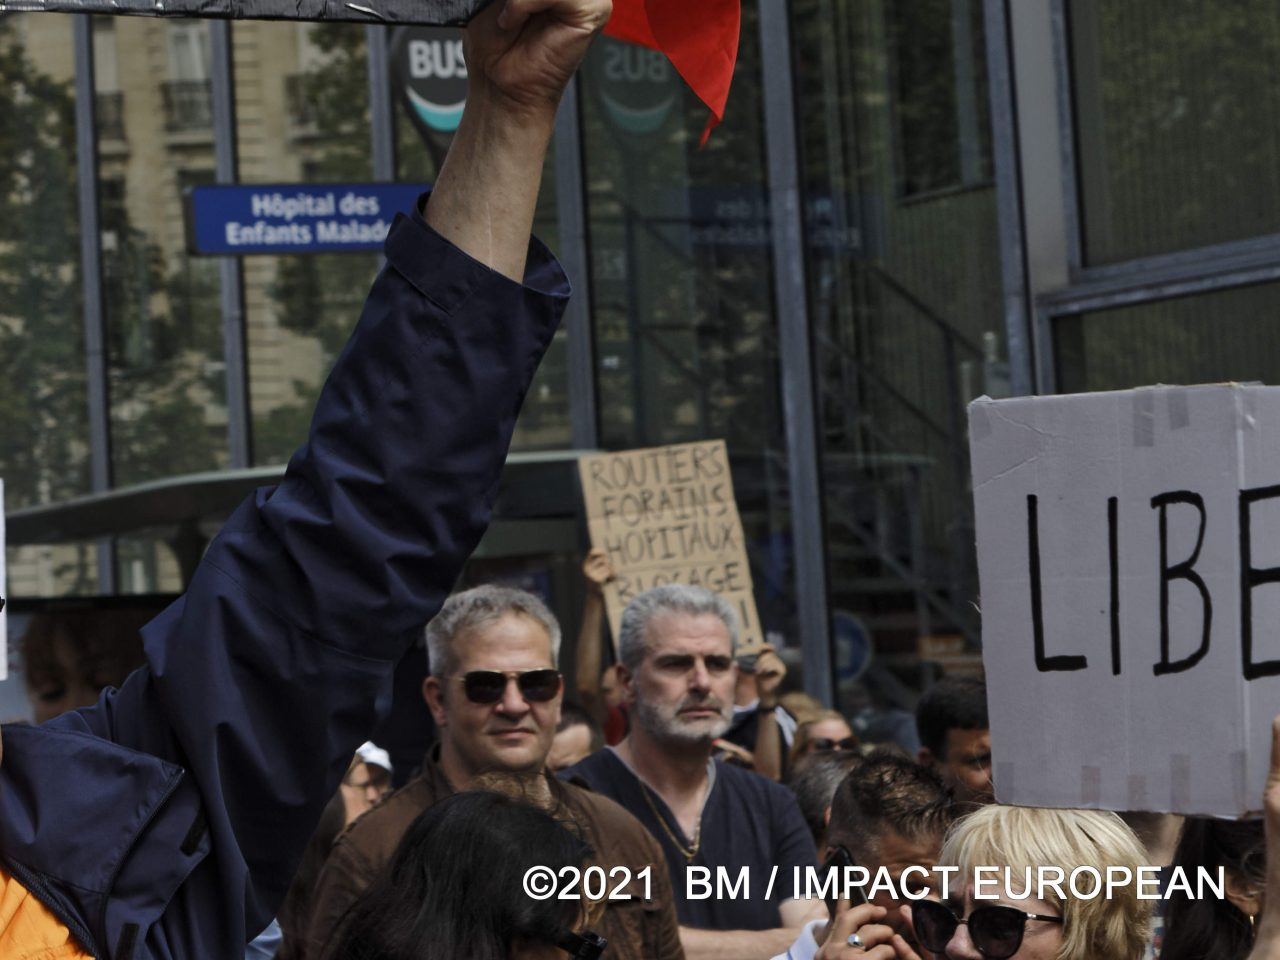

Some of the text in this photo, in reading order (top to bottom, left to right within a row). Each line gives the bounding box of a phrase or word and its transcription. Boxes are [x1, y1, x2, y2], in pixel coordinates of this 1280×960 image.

[252, 192, 380, 220] Hôpital des
[225, 221, 312, 246] Enfants
[588, 445, 724, 492] ROUTIERS
[602, 484, 728, 529] FORAINS
[605, 521, 737, 566] HOPITAUX
[1027, 488, 1280, 680] LIBE
